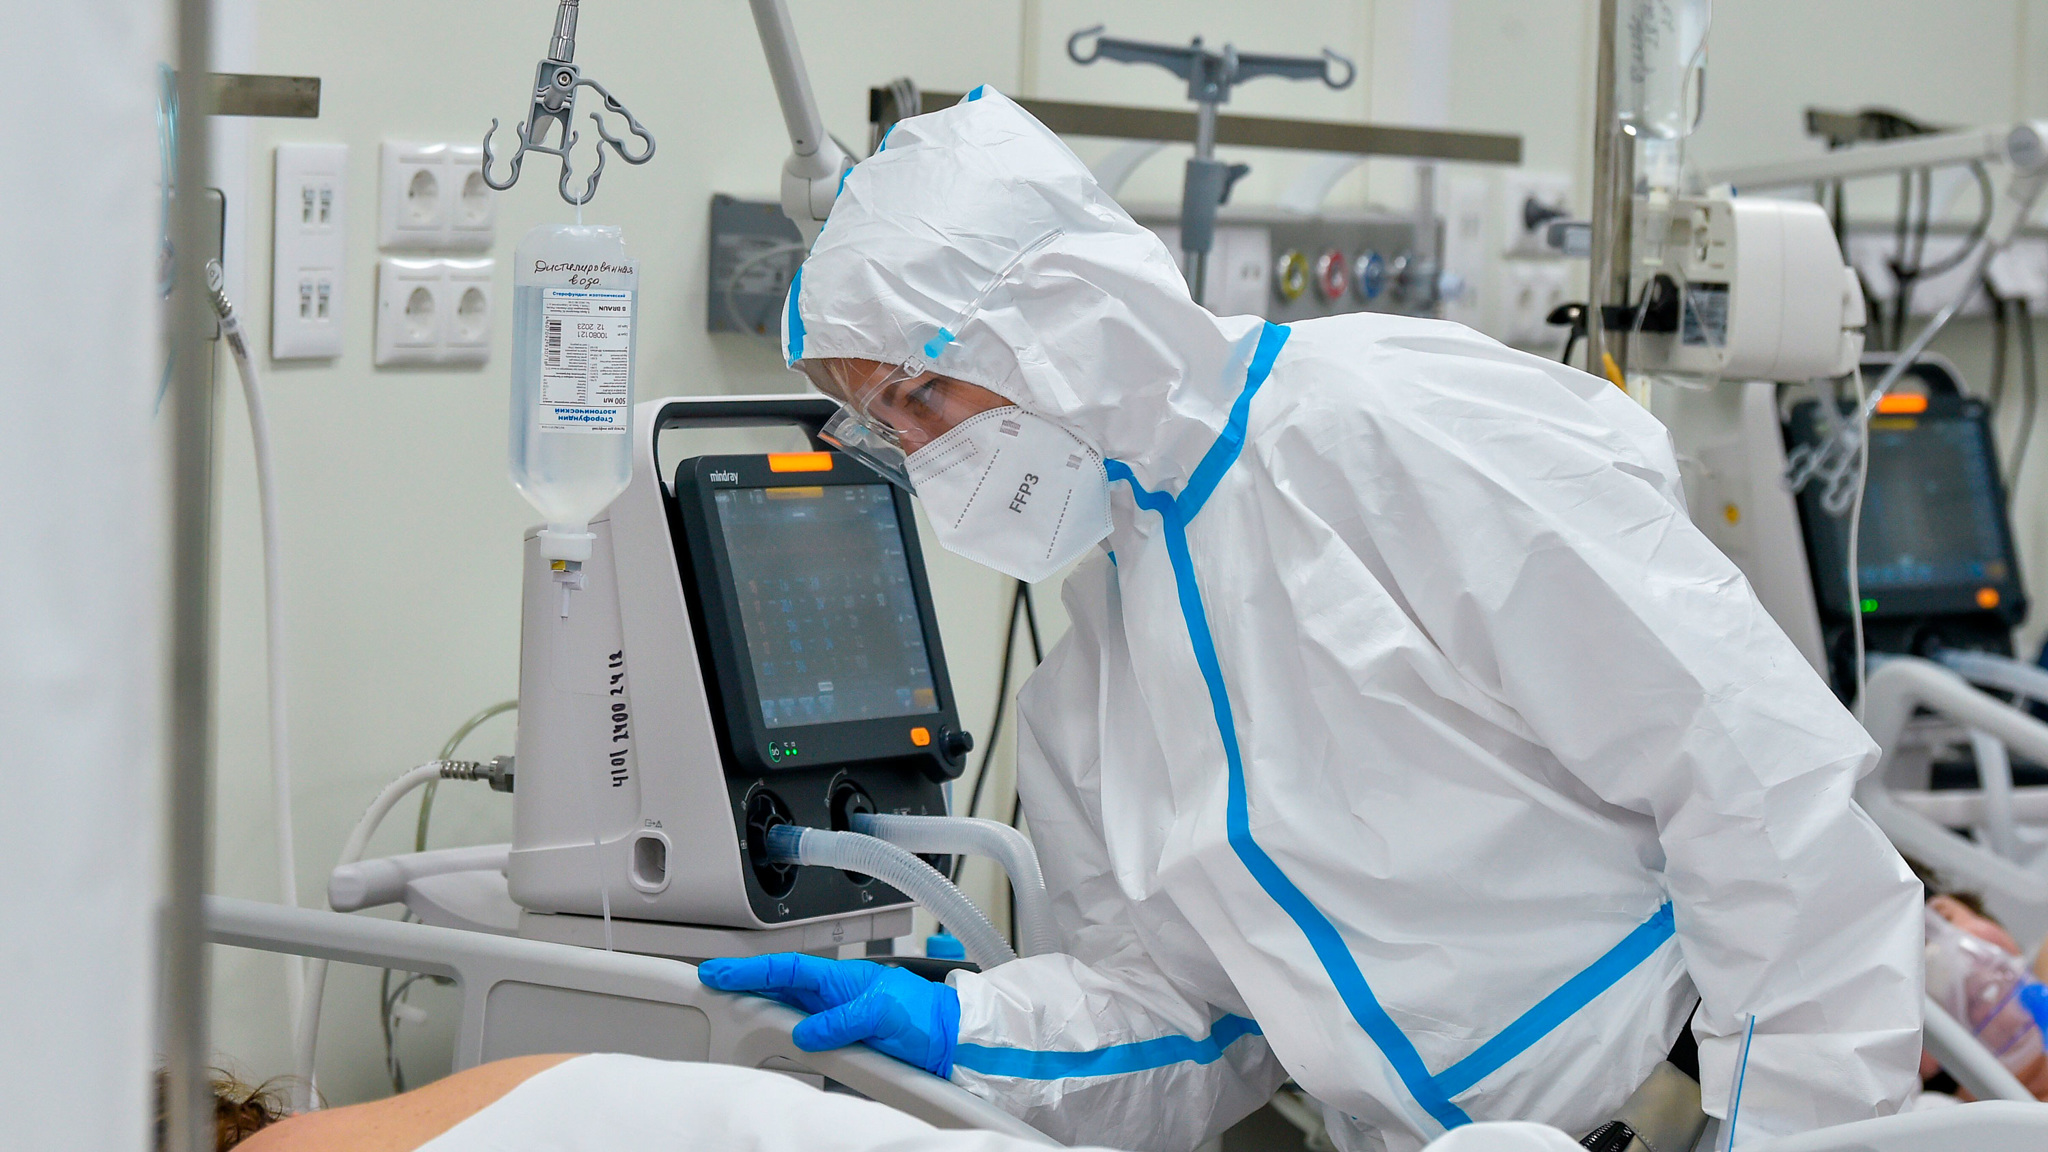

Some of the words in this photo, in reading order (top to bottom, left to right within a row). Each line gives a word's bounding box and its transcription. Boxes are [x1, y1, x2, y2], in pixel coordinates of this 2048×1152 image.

[597, 323, 605, 331] 12
[577, 330, 608, 339] 10080121
[614, 397, 626, 405] 500
[555, 408, 617, 416] изотонический
[709, 470, 738, 485] mindray
[1008, 473, 1040, 514] FFP3
[612, 703, 629, 743] 2400
[609, 749, 629, 788] 4101
